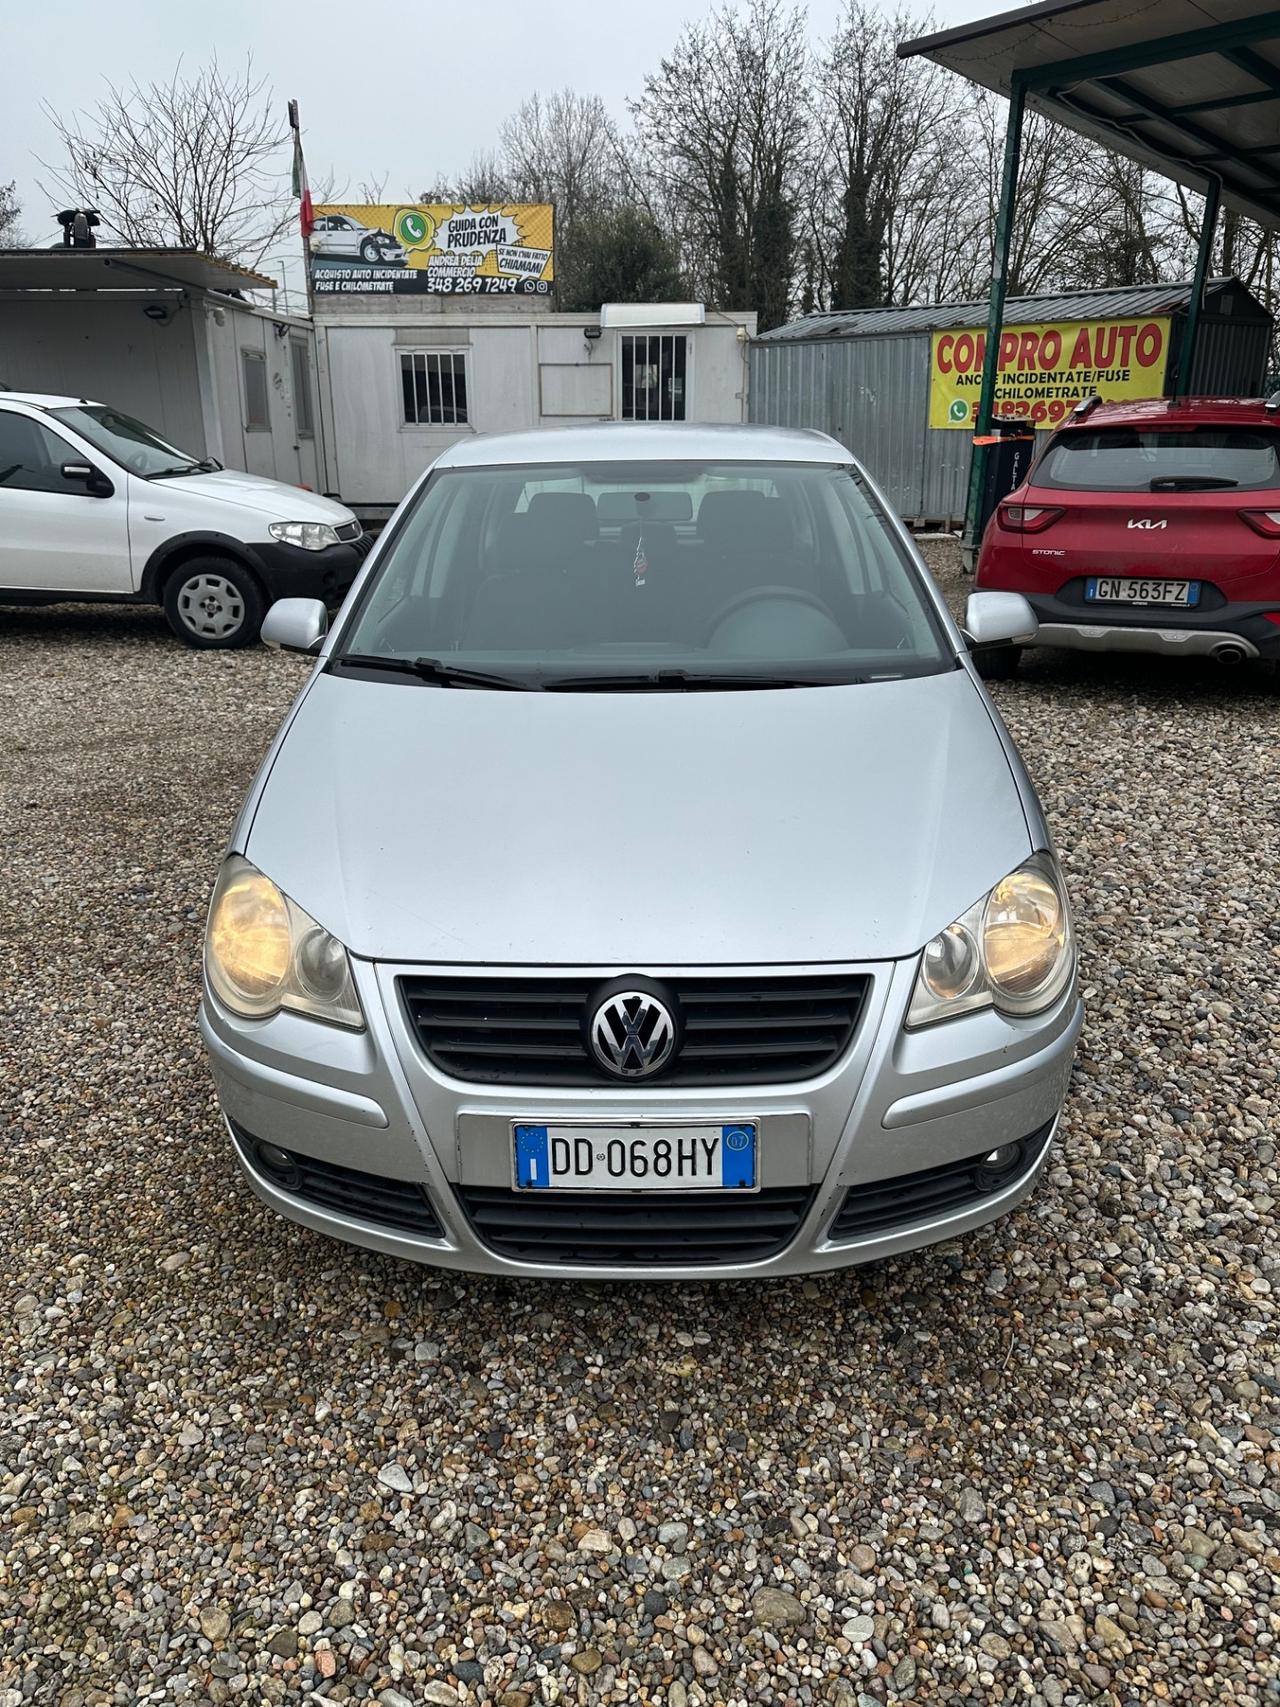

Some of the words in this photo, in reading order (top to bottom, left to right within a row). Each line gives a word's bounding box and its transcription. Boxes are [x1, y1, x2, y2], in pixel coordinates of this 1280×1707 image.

[448, 217, 477, 233] GUIDA
[479, 215, 499, 229] CON
[447, 228, 507, 248] PRUDENZA
[428, 255, 459, 267] ANDREA
[500, 257, 543, 273] CHIAMAMI
[315, 269, 351, 279] ACQUISTO
[352, 269, 372, 279] AUTO
[373, 270, 417, 279] INCIDENTATE
[427, 266, 476, 277] COMMERCIO
[316, 281, 334, 291] FUSE
[335, 282, 340, 290] E
[341, 281, 394, 291] CHILOMETRATE
[427, 278, 453, 292] 348
[455, 278, 481, 293] 269
[485, 278, 517, 293] 7249
[1068, 323, 1163, 369] AUTO
[1002, 369, 1130, 385] INCIDENTATE/FUSE
[995, 386, 1097, 399] CHILOMETRATE
[1127, 519, 1168, 529] KIA
[1098, 580, 1121, 599] GN
[1127, 581, 1187, 602] 563FZ
[551, 1137, 594, 1176] DD
[606, 1137, 720, 1178] 068HY
